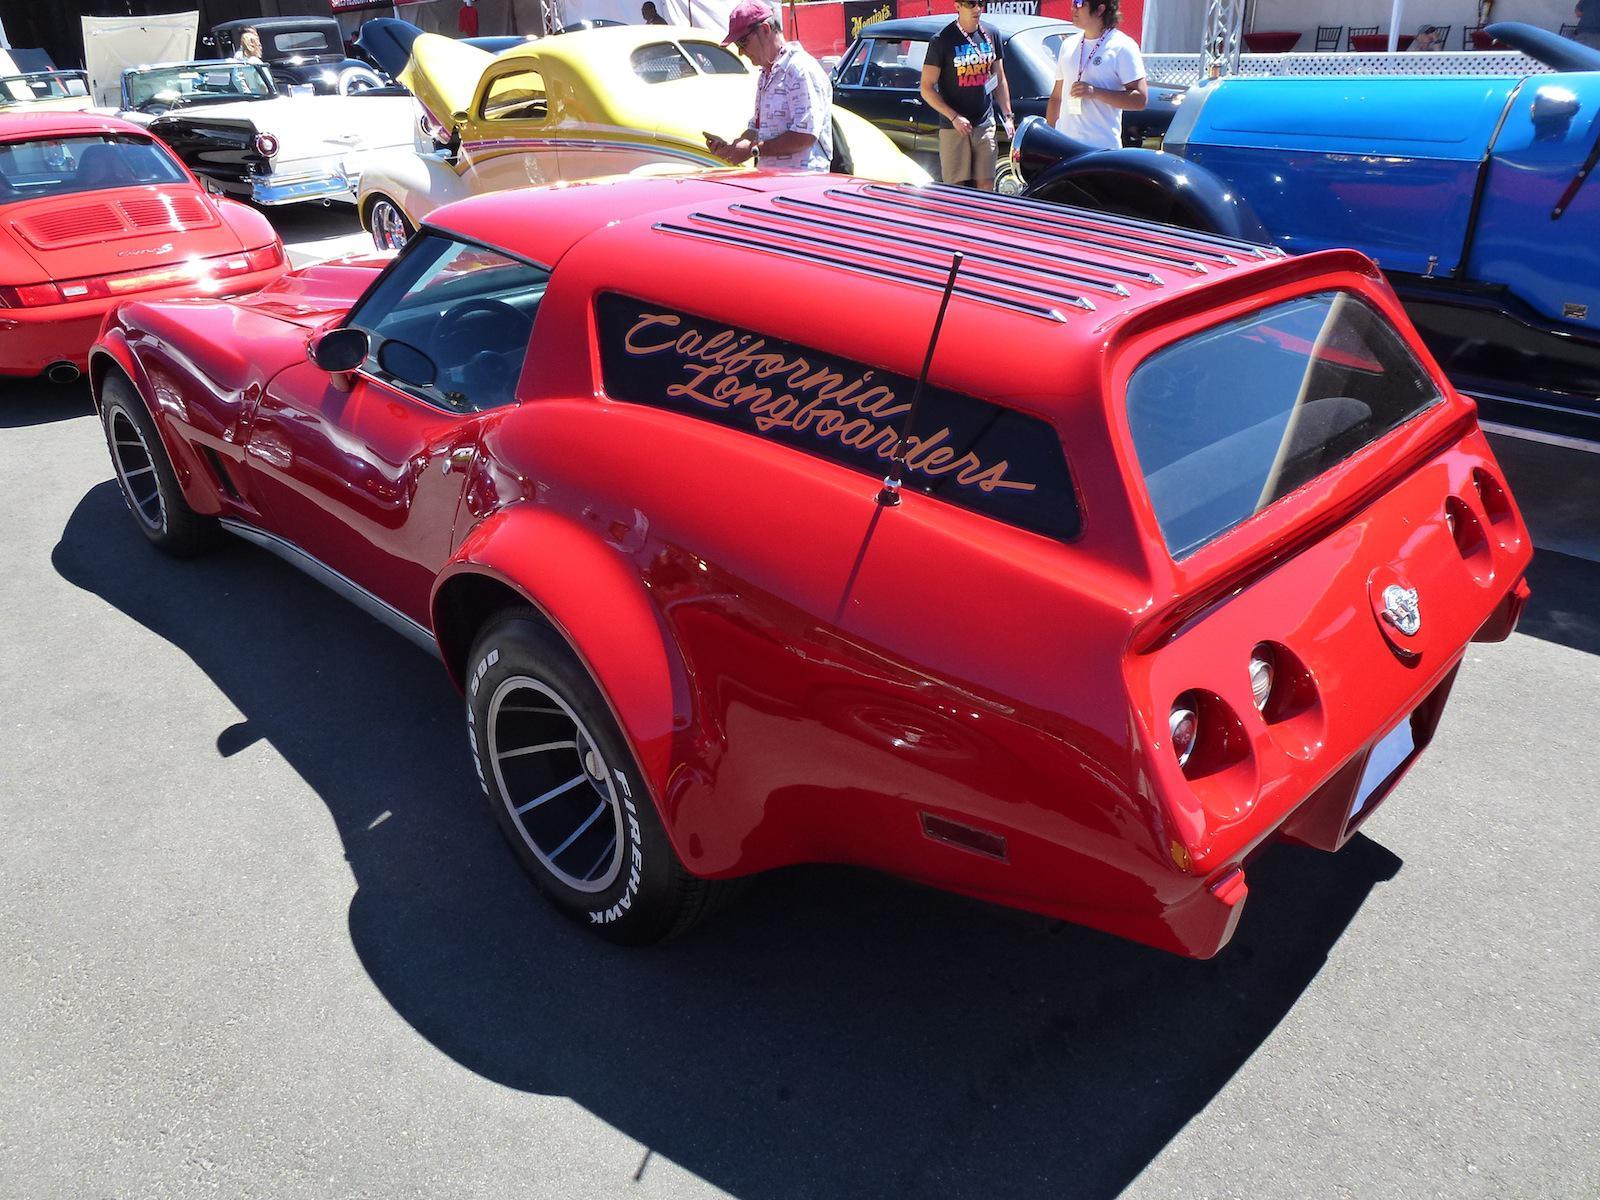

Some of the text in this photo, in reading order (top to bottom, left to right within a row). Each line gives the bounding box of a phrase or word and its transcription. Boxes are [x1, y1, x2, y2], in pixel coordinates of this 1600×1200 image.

[987, 1, 1038, 15] HAGERTY
[625, 314, 911, 418] California
[667, 364, 1036, 492] Longboarders
[589, 768, 642, 924] FIREHAWK
